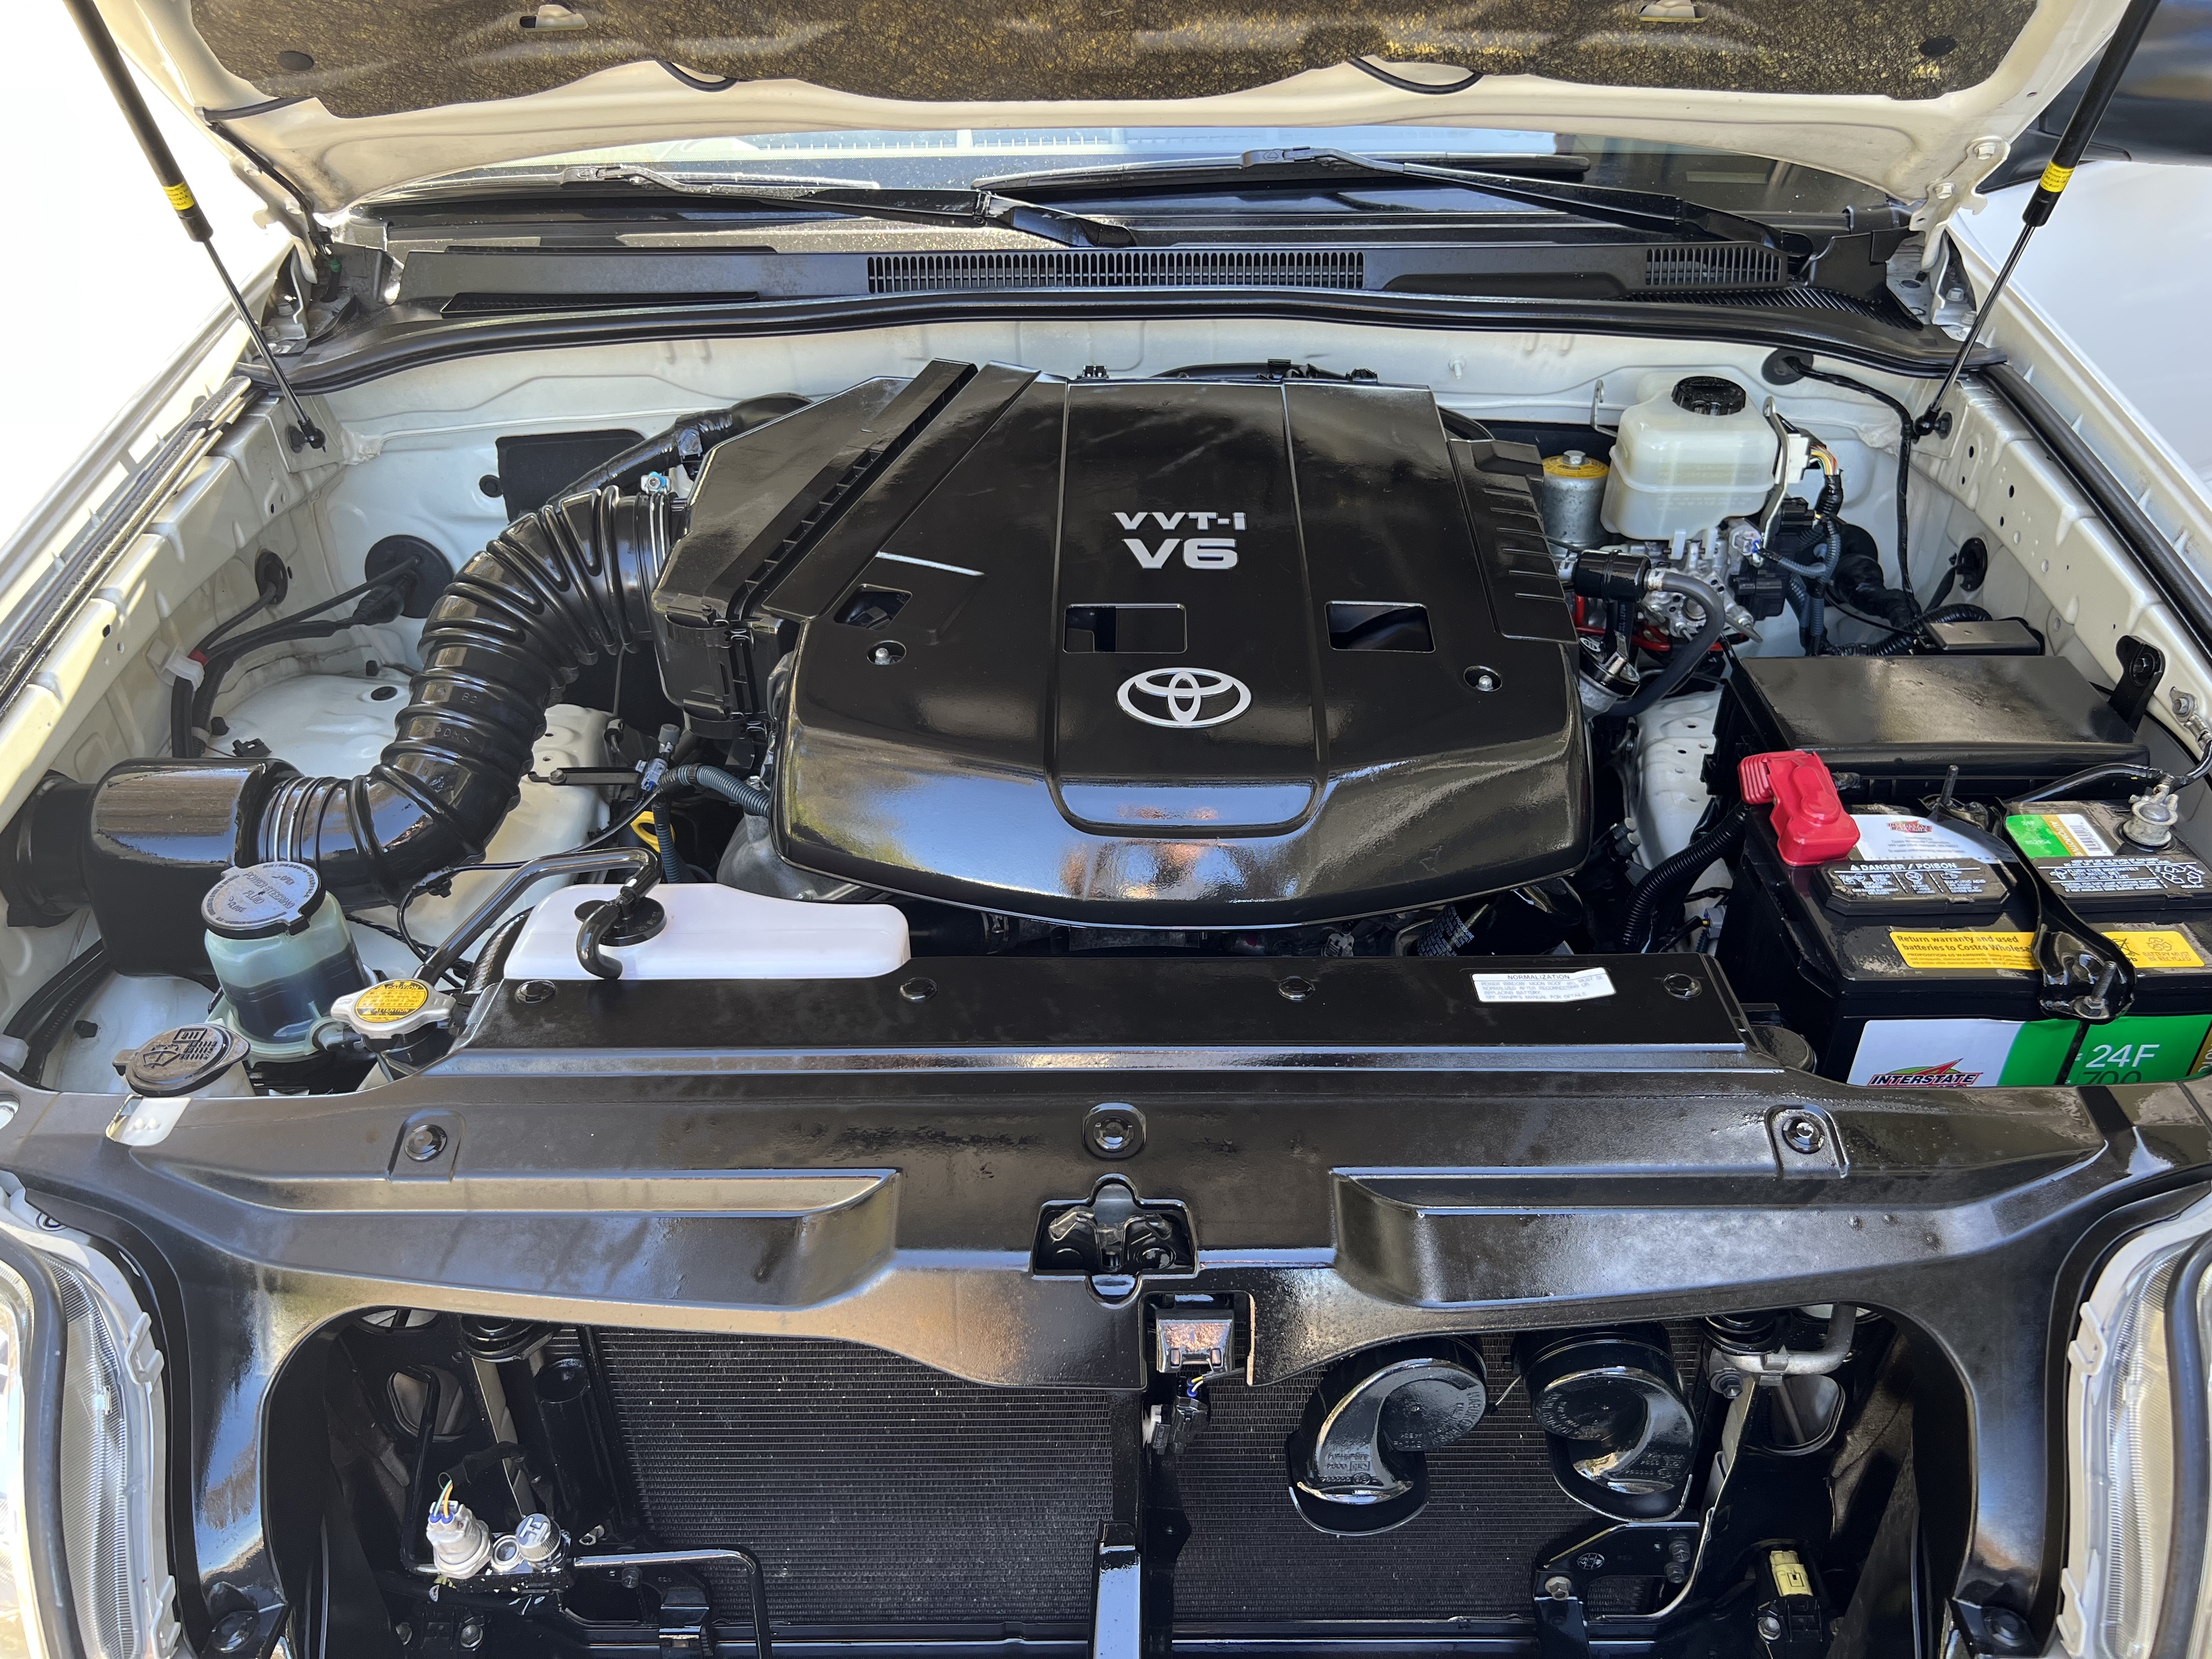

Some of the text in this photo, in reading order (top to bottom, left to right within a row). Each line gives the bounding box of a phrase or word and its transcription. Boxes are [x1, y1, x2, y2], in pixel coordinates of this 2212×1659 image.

[1121, 538, 1238, 570] V6
[2049, 821, 2084, 856] AUTOMOTIVE
[243, 871, 268, 888] POWER
[263, 885, 295, 909] STEERING
[280, 875, 295, 885] OPEN
[242, 889, 266, 905] FLUID
[1455, 916, 1475, 940] PROCEDURE
[2085, 1043, 2160, 1068] 24F
[1870, 1074, 1977, 1085] INTERSTATE
